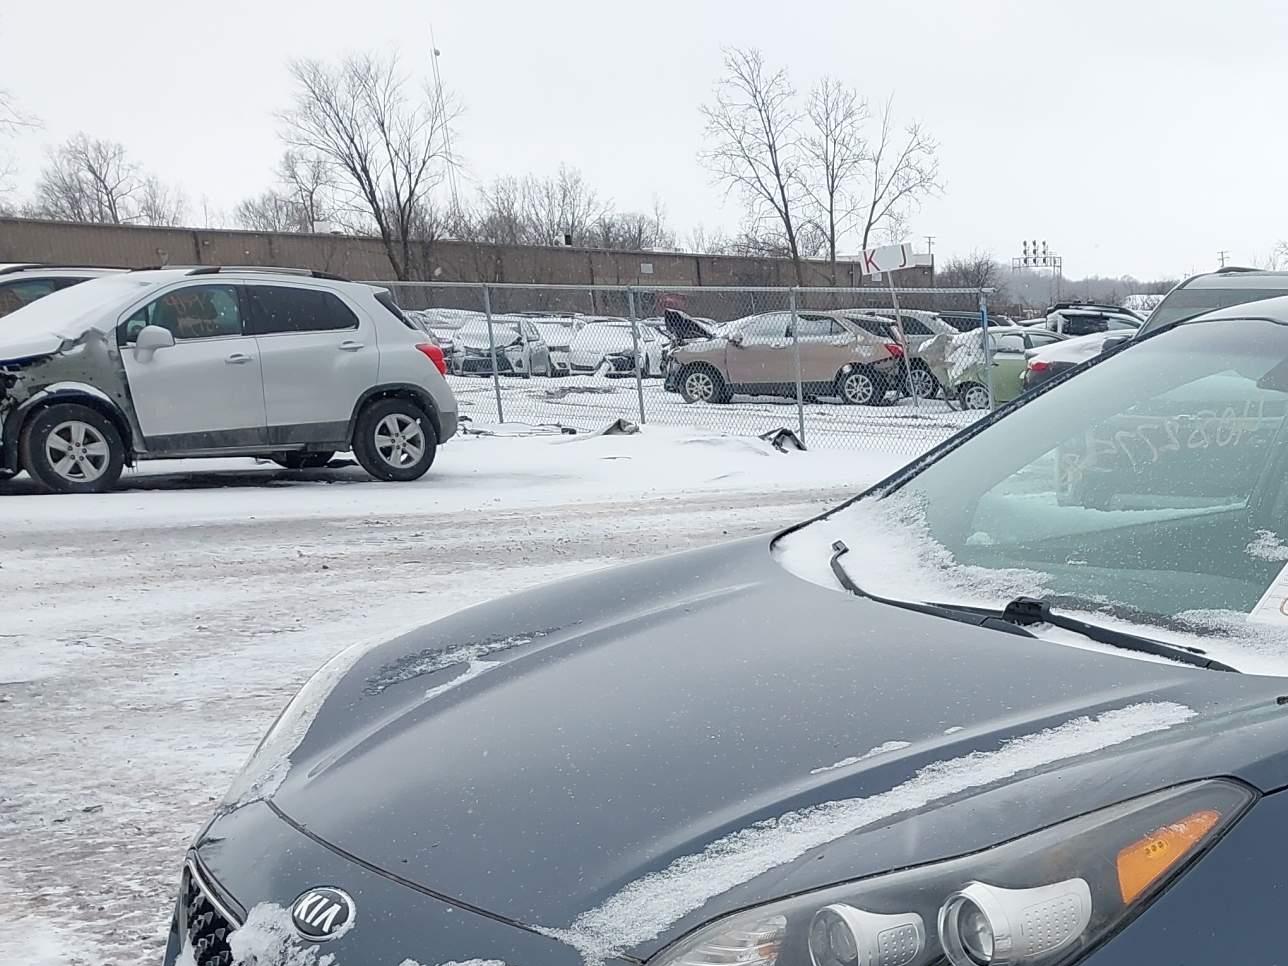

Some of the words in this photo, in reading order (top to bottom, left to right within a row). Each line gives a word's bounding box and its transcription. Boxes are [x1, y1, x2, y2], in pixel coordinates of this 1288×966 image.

[864, 249, 880, 273] K
[899, 244, 906, 268] J
[293, 892, 342, 933] KIA
